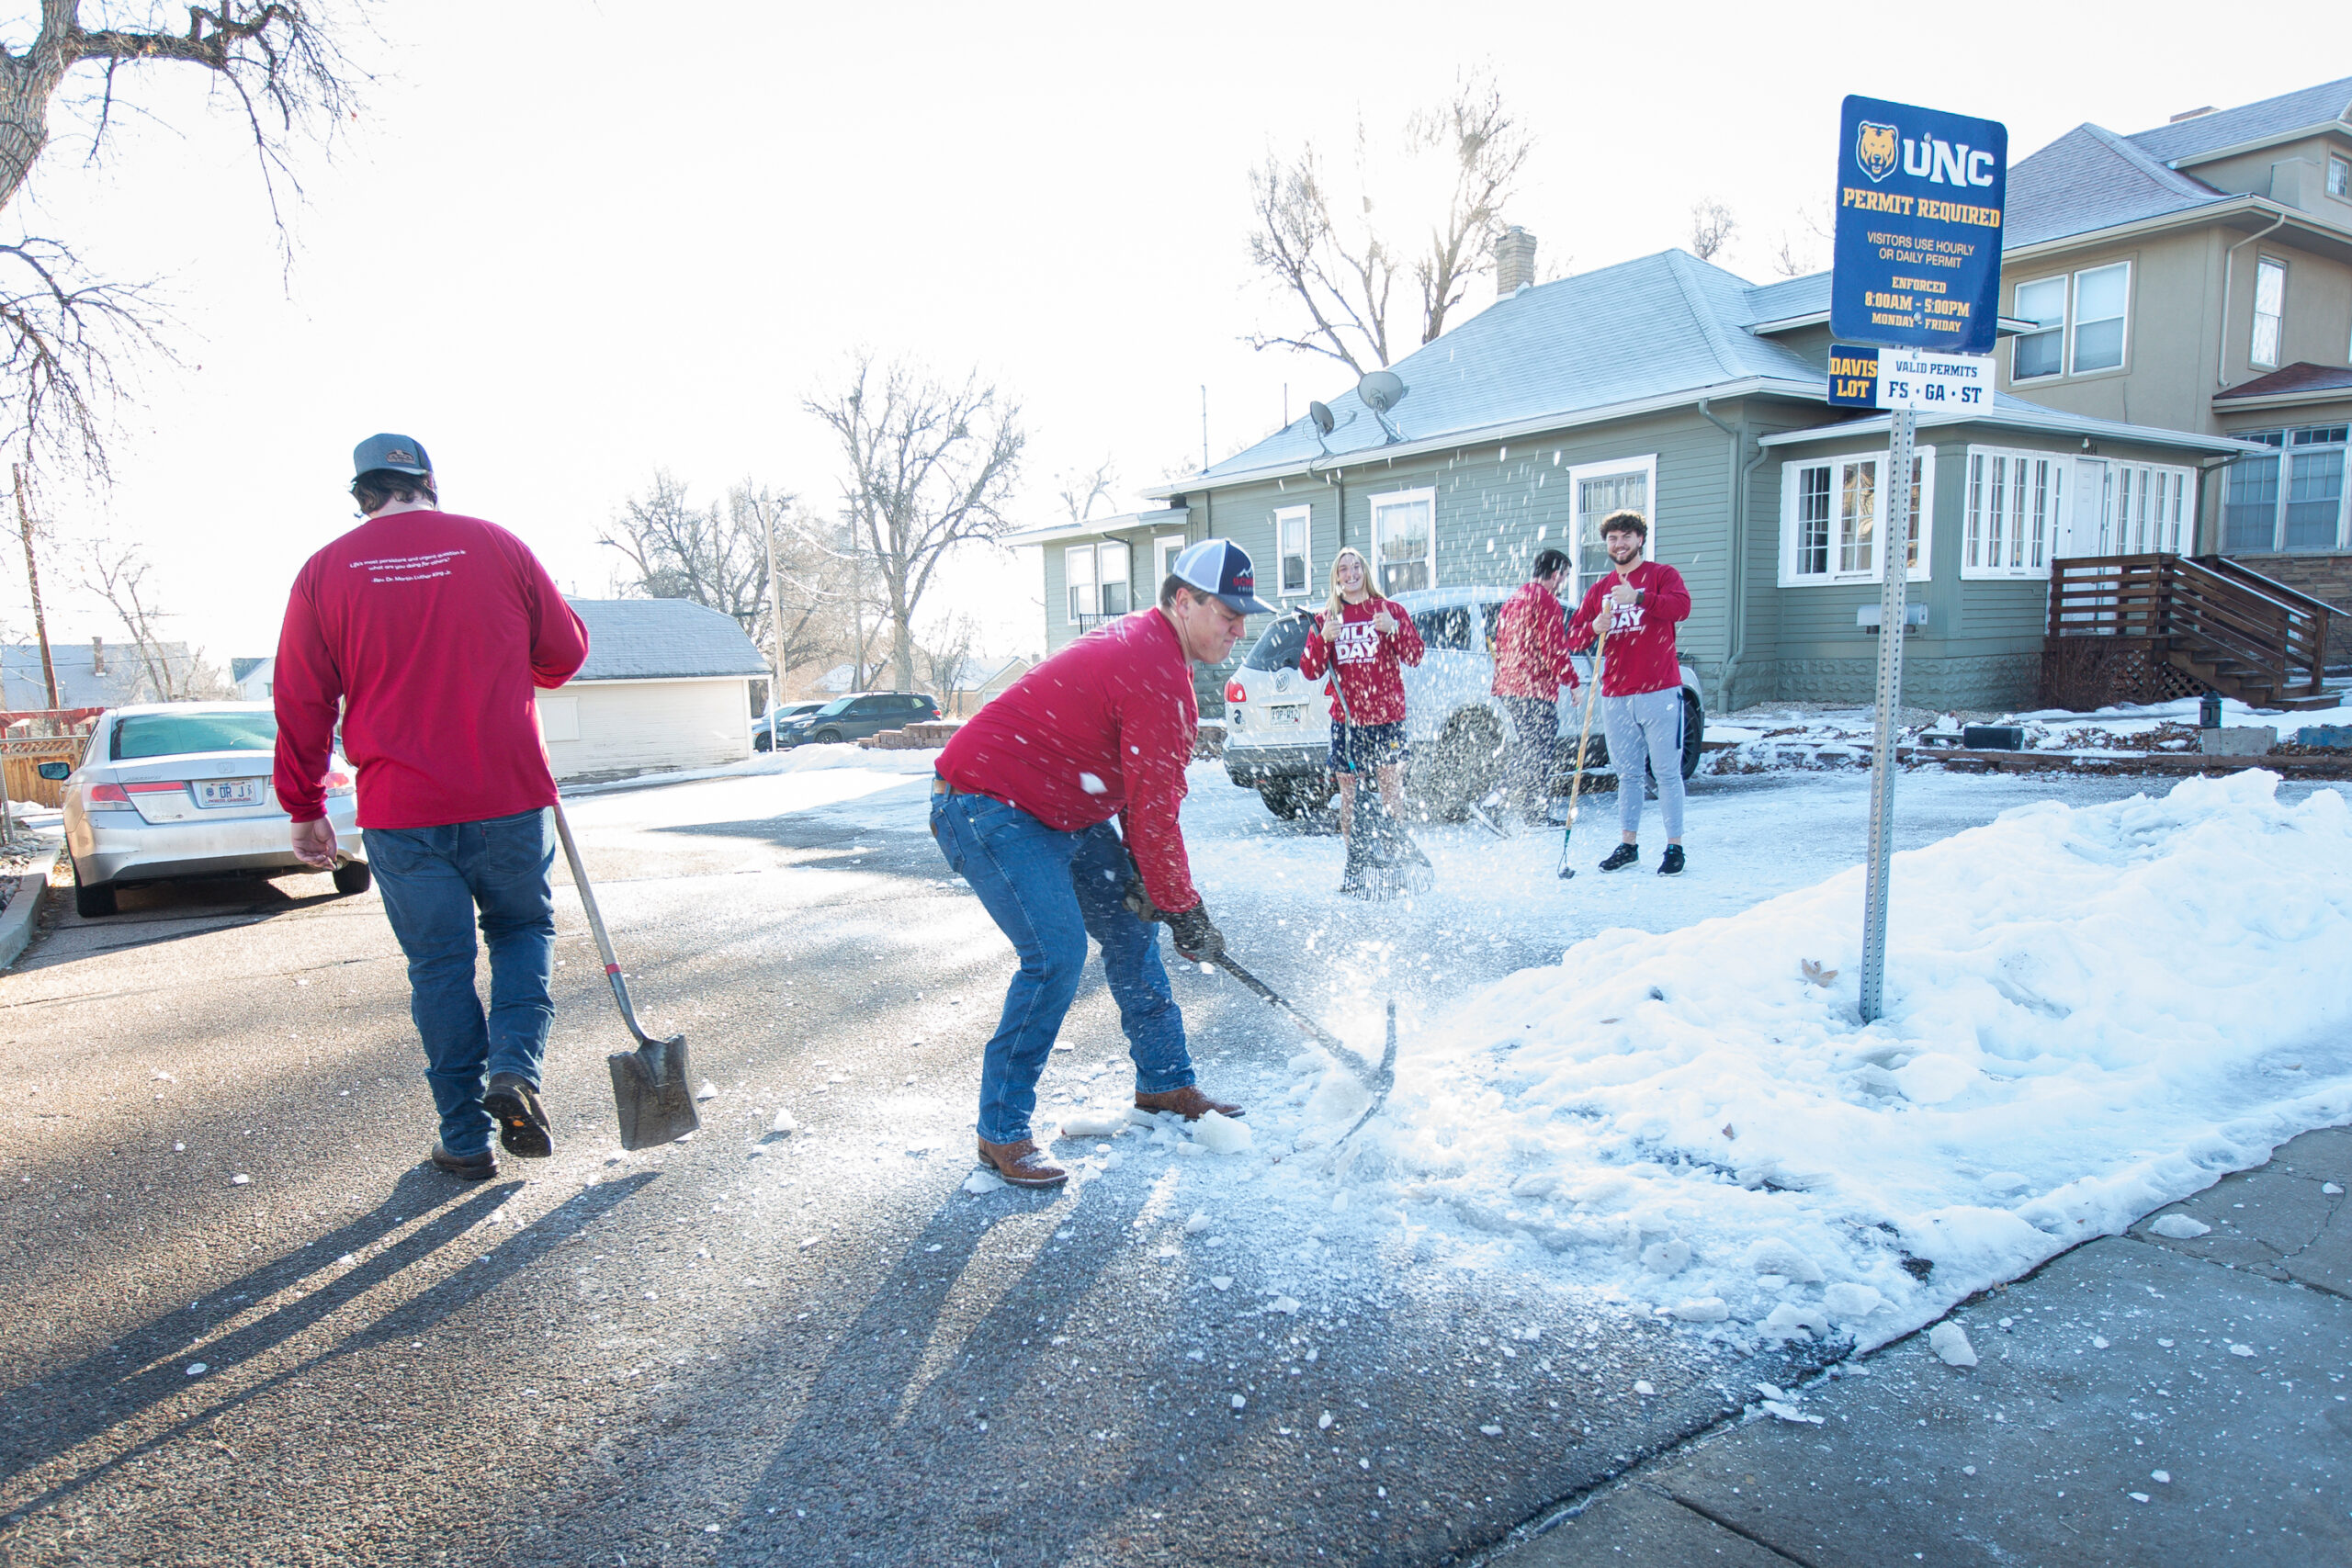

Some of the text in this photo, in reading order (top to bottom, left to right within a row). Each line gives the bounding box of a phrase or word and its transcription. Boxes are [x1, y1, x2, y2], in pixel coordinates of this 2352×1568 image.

[1903, 139, 1995, 187] UNC
[1843, 187, 2000, 228] PERMIT REQUIRED
[1867, 231, 1974, 256] VISITORS USE HOURLY
[1879, 247, 1962, 268] OR DAILY PERMIT
[1892, 276, 1947, 294] ENFORCED
[1865, 291, 1914, 310] 8:00AM
[1924, 299, 1971, 318] 5:00PM
[1871, 312, 1915, 329] MONDAY
[1925, 319, 1962, 333] FRIDAY
[1829, 356, 1878, 378] DAVIS
[1895, 360, 1978, 378] VALID PERMITS
[1837, 379, 1870, 399] LOT
[1889, 381, 1982, 403] FS GA ST
[1334, 624, 1379, 641] MLK
[1335, 640, 1380, 660] DAY
[238, 785, 244, 797] J
